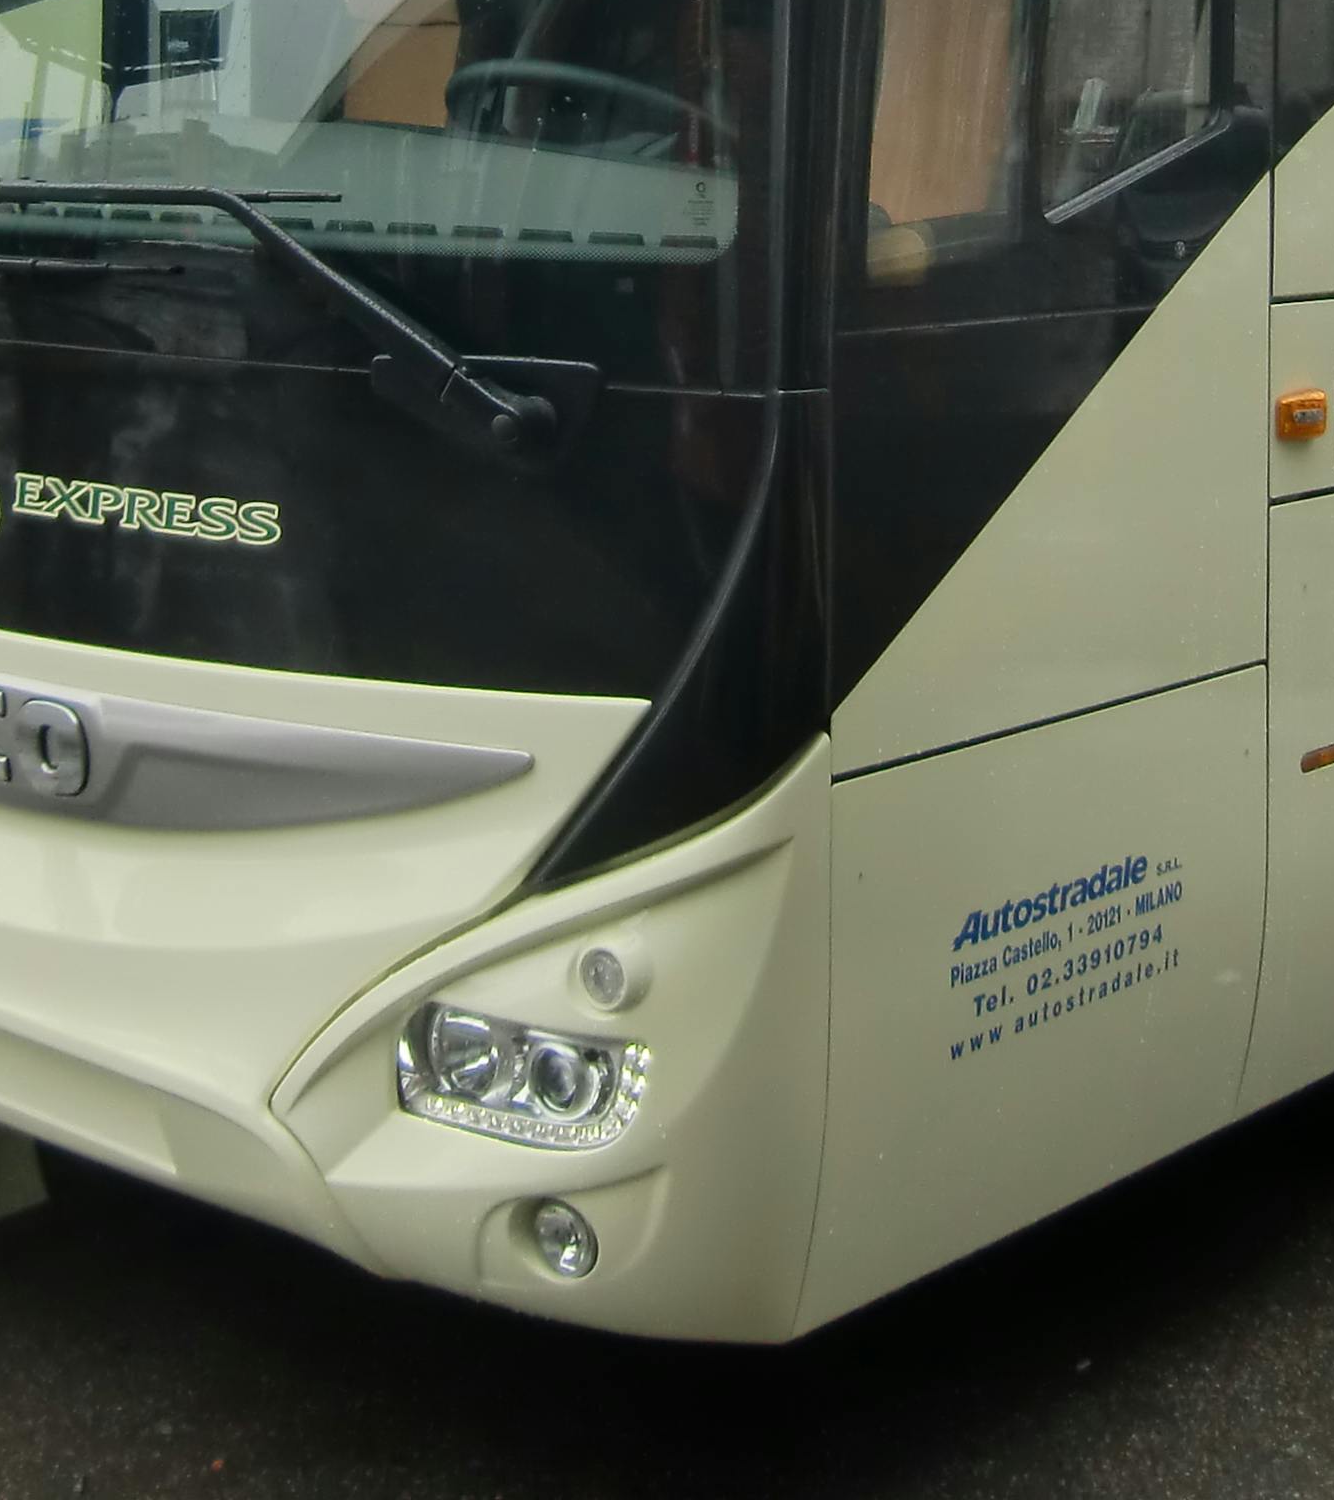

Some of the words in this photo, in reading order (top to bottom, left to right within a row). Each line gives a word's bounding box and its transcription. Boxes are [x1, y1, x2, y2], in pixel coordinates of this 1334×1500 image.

[12, 472, 282, 546] EXPRESS
[950, 955, 998, 989] Piazza
[1002, 930, 1062, 968] Castello,
[1067, 921, 1073, 943] 1
[1087, 904, 1122, 937] 20121
[1135, 880, 1183, 917] MILANO
[952, 854, 1149, 952] Autostradale
[973, 984, 1015, 1017] Tel.
[1026, 923, 1164, 996] 02.33910794
